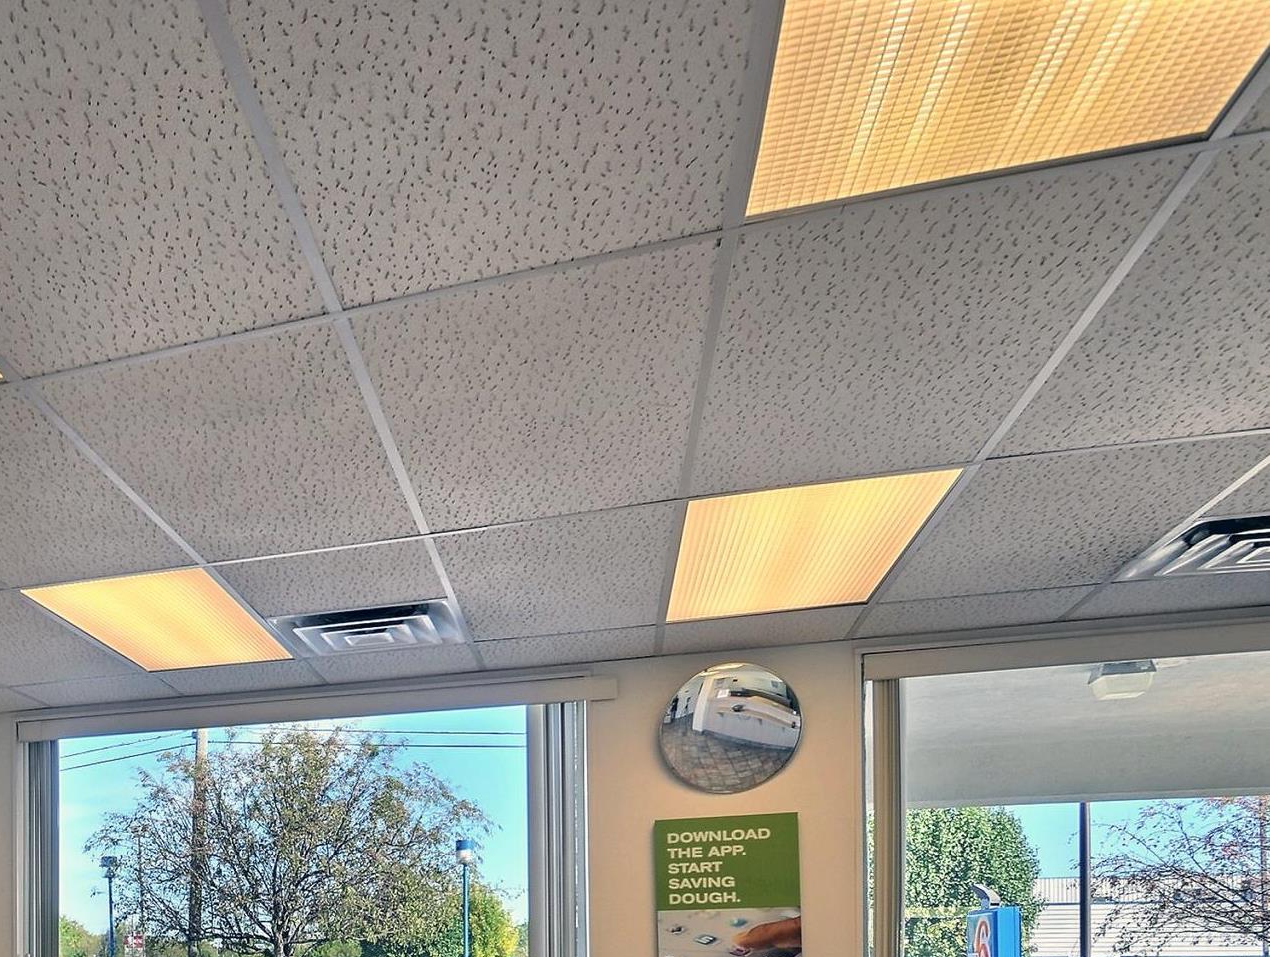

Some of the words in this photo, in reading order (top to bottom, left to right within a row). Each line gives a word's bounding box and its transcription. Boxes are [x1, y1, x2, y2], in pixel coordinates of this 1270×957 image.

[667, 828, 771, 844] DOWNLOAD
[667, 847, 704, 859] THE
[708, 845, 747, 857] APP.
[667, 861, 723, 874] START
[668, 876, 736, 889] SAVING
[668, 891, 741, 904] DOUGH.
